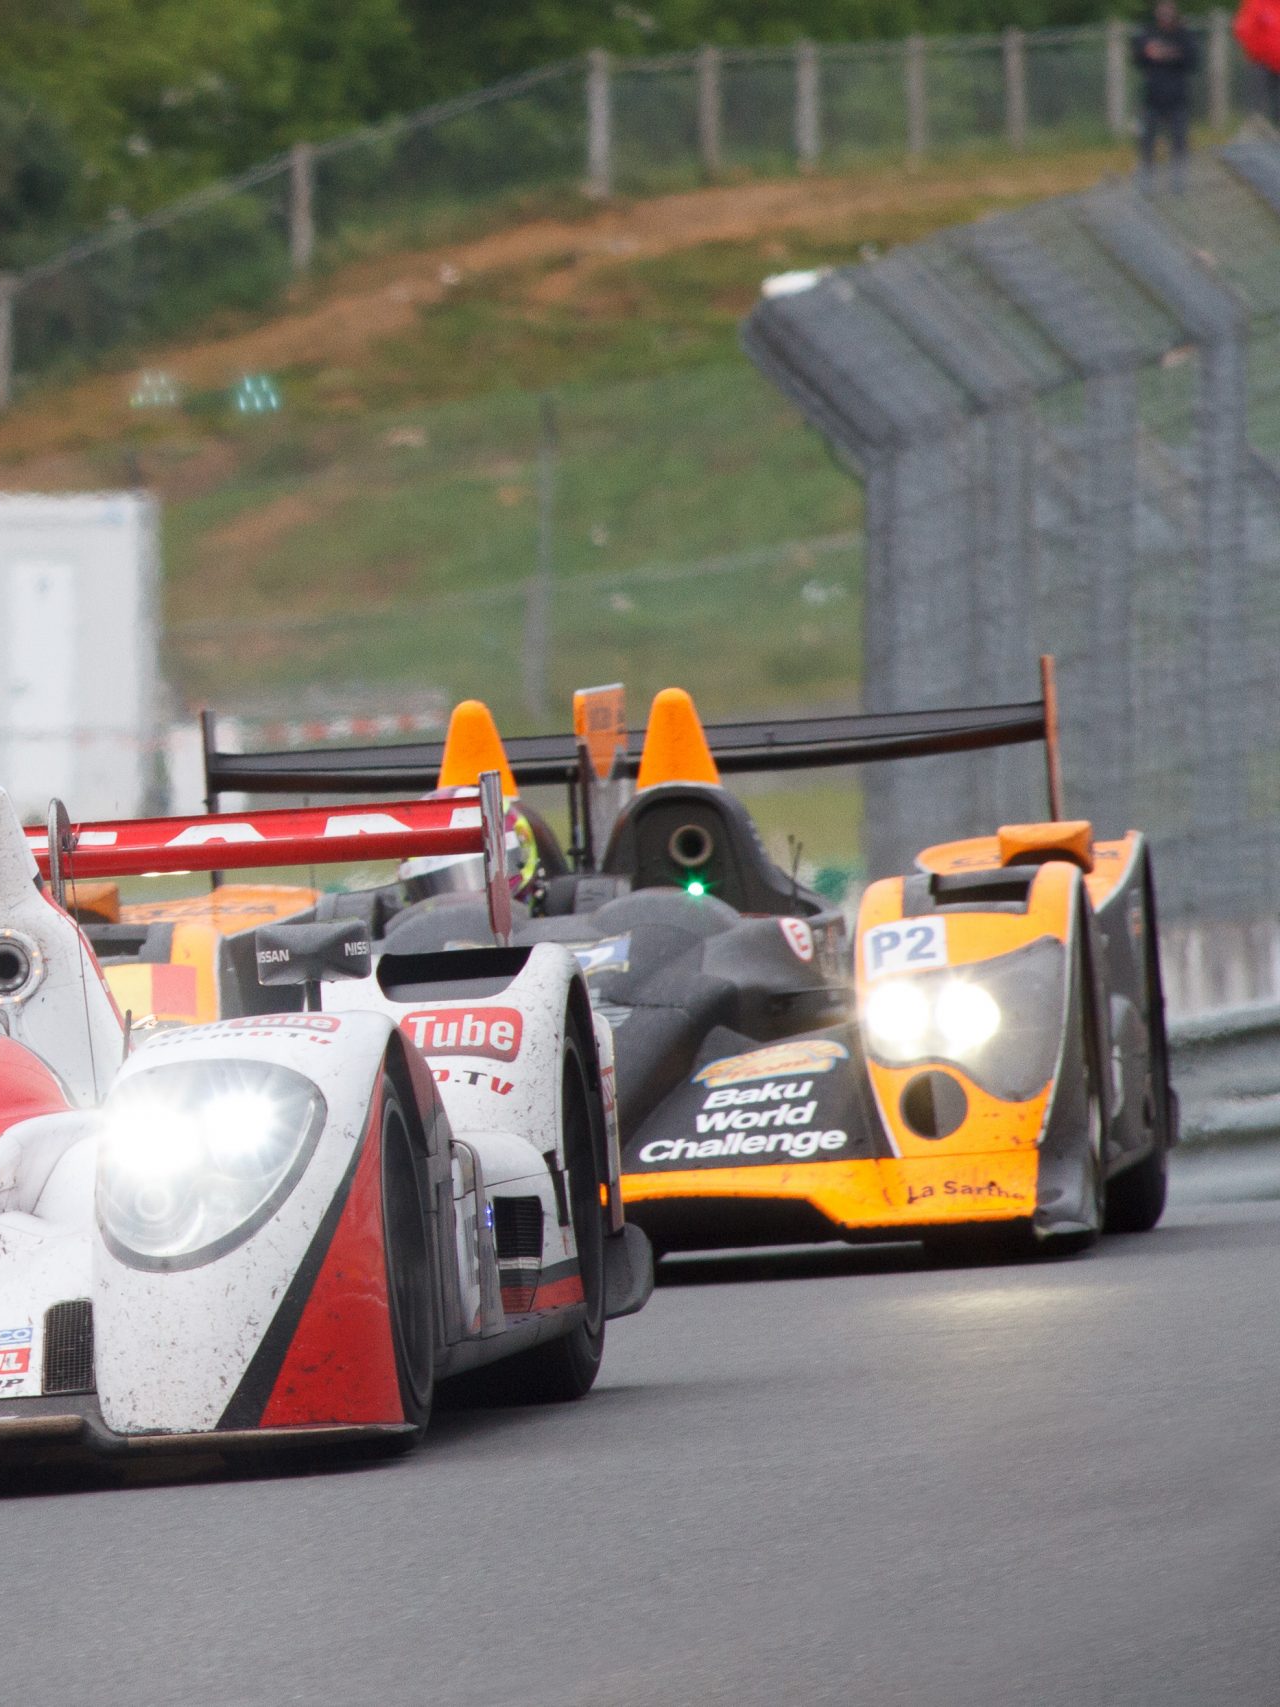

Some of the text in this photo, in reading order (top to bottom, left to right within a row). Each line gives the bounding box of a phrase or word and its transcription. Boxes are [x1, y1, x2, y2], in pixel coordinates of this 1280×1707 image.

[871, 926, 937, 971] P2
[702, 1080, 814, 1110] Baku
[695, 1100, 819, 1134] World
[638, 1128, 849, 1163] Challenge
[907, 1185, 935, 1204] La
